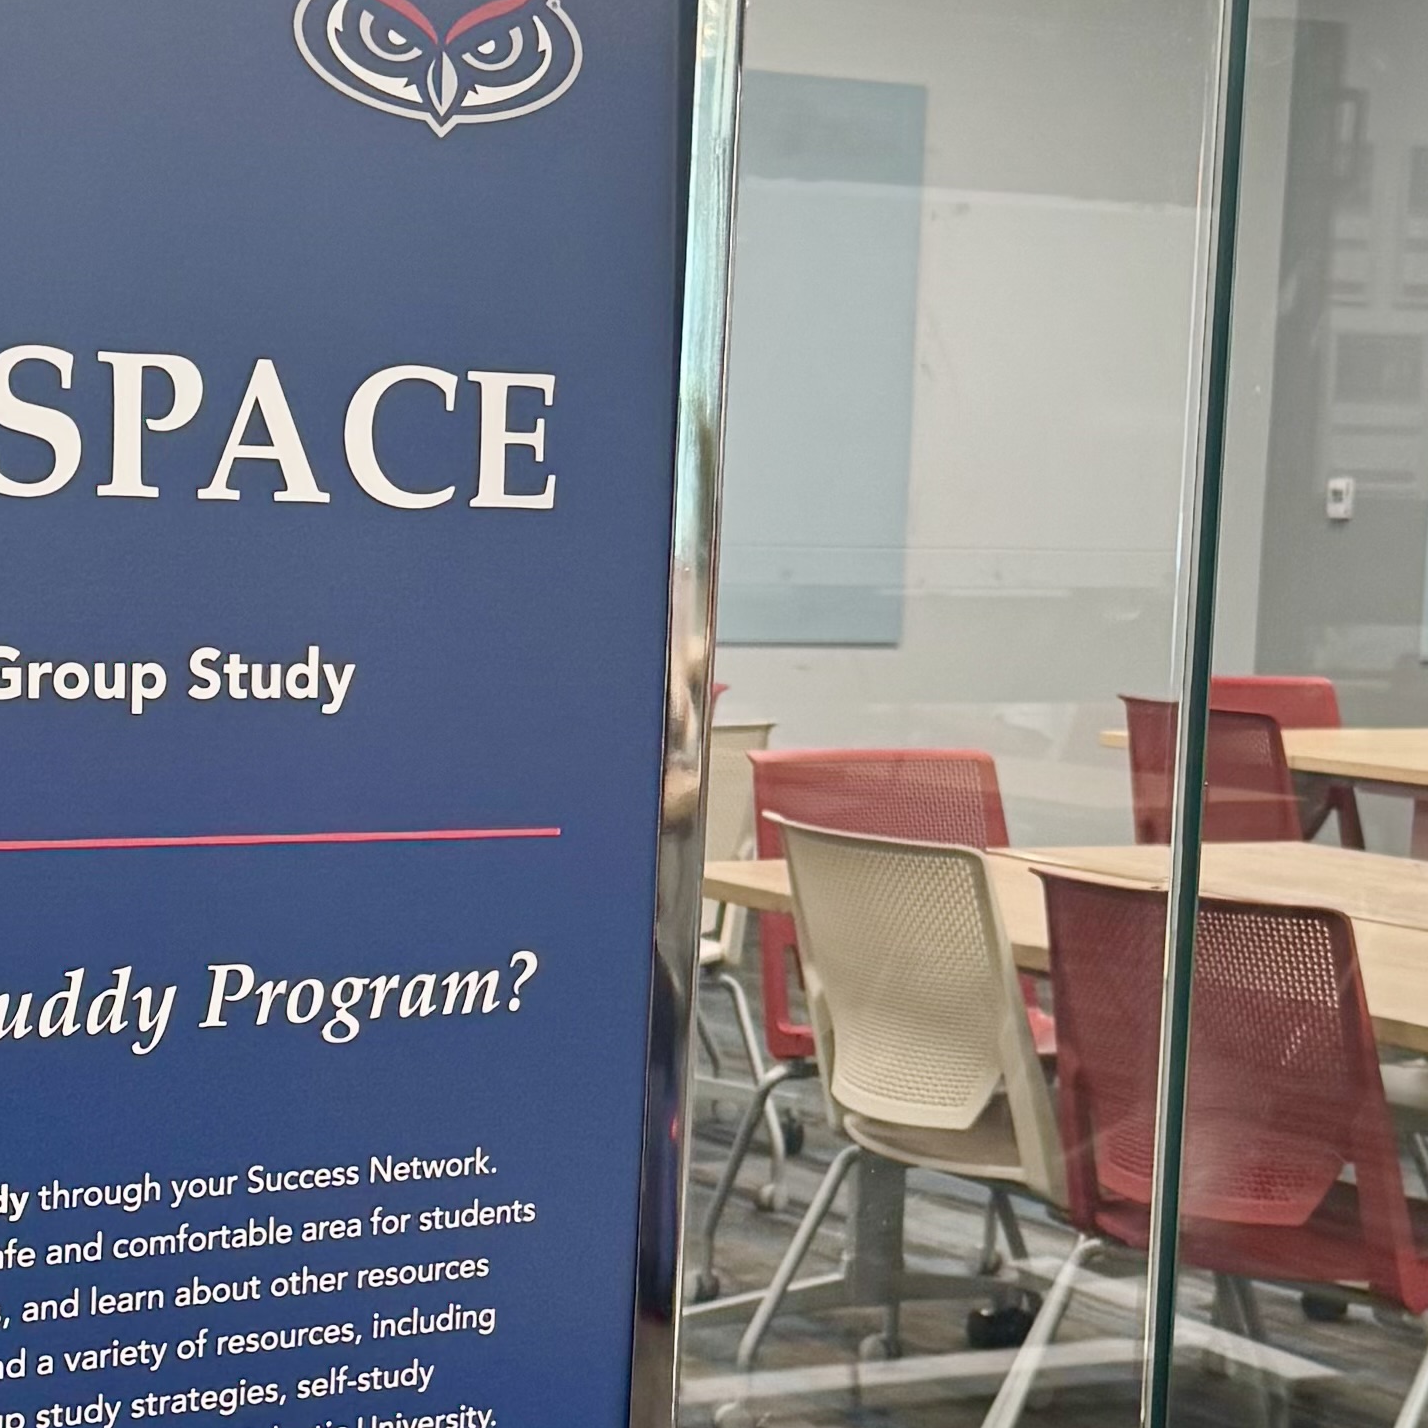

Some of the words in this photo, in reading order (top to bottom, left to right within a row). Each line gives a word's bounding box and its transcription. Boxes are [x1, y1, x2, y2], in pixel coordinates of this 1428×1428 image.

[187, 645, 356, 715] Study
[198, 950, 538, 1044] Program?
[37, 1172, 161, 1212] through
[170, 1175, 239, 1208] your
[247, 1165, 360, 1194] Success
[369, 1146, 497, 1184] Network.
[45, 1230, 103, 1265] and
[112, 1216, 293, 1259] comfortable
[301, 1218, 362, 1242] area
[369, 1206, 412, 1236] for
[419, 1198, 536, 1232] students
[22, 1287, 79, 1323] and
[90, 1285, 164, 1316] learn
[174, 1275, 262, 1307] about
[270, 1265, 349, 1297] other
[357, 1258, 490, 1289] resources
[36, 1355, 54, 1375] a
[63, 1339, 168, 1372] variety
[176, 1328, 209, 1360] of
[217, 1322, 362, 1356] resources,
[372, 1302, 496, 1339] including
[131, 1378, 287, 1419] strategies,
[296, 1358, 435, 1399] self-study
